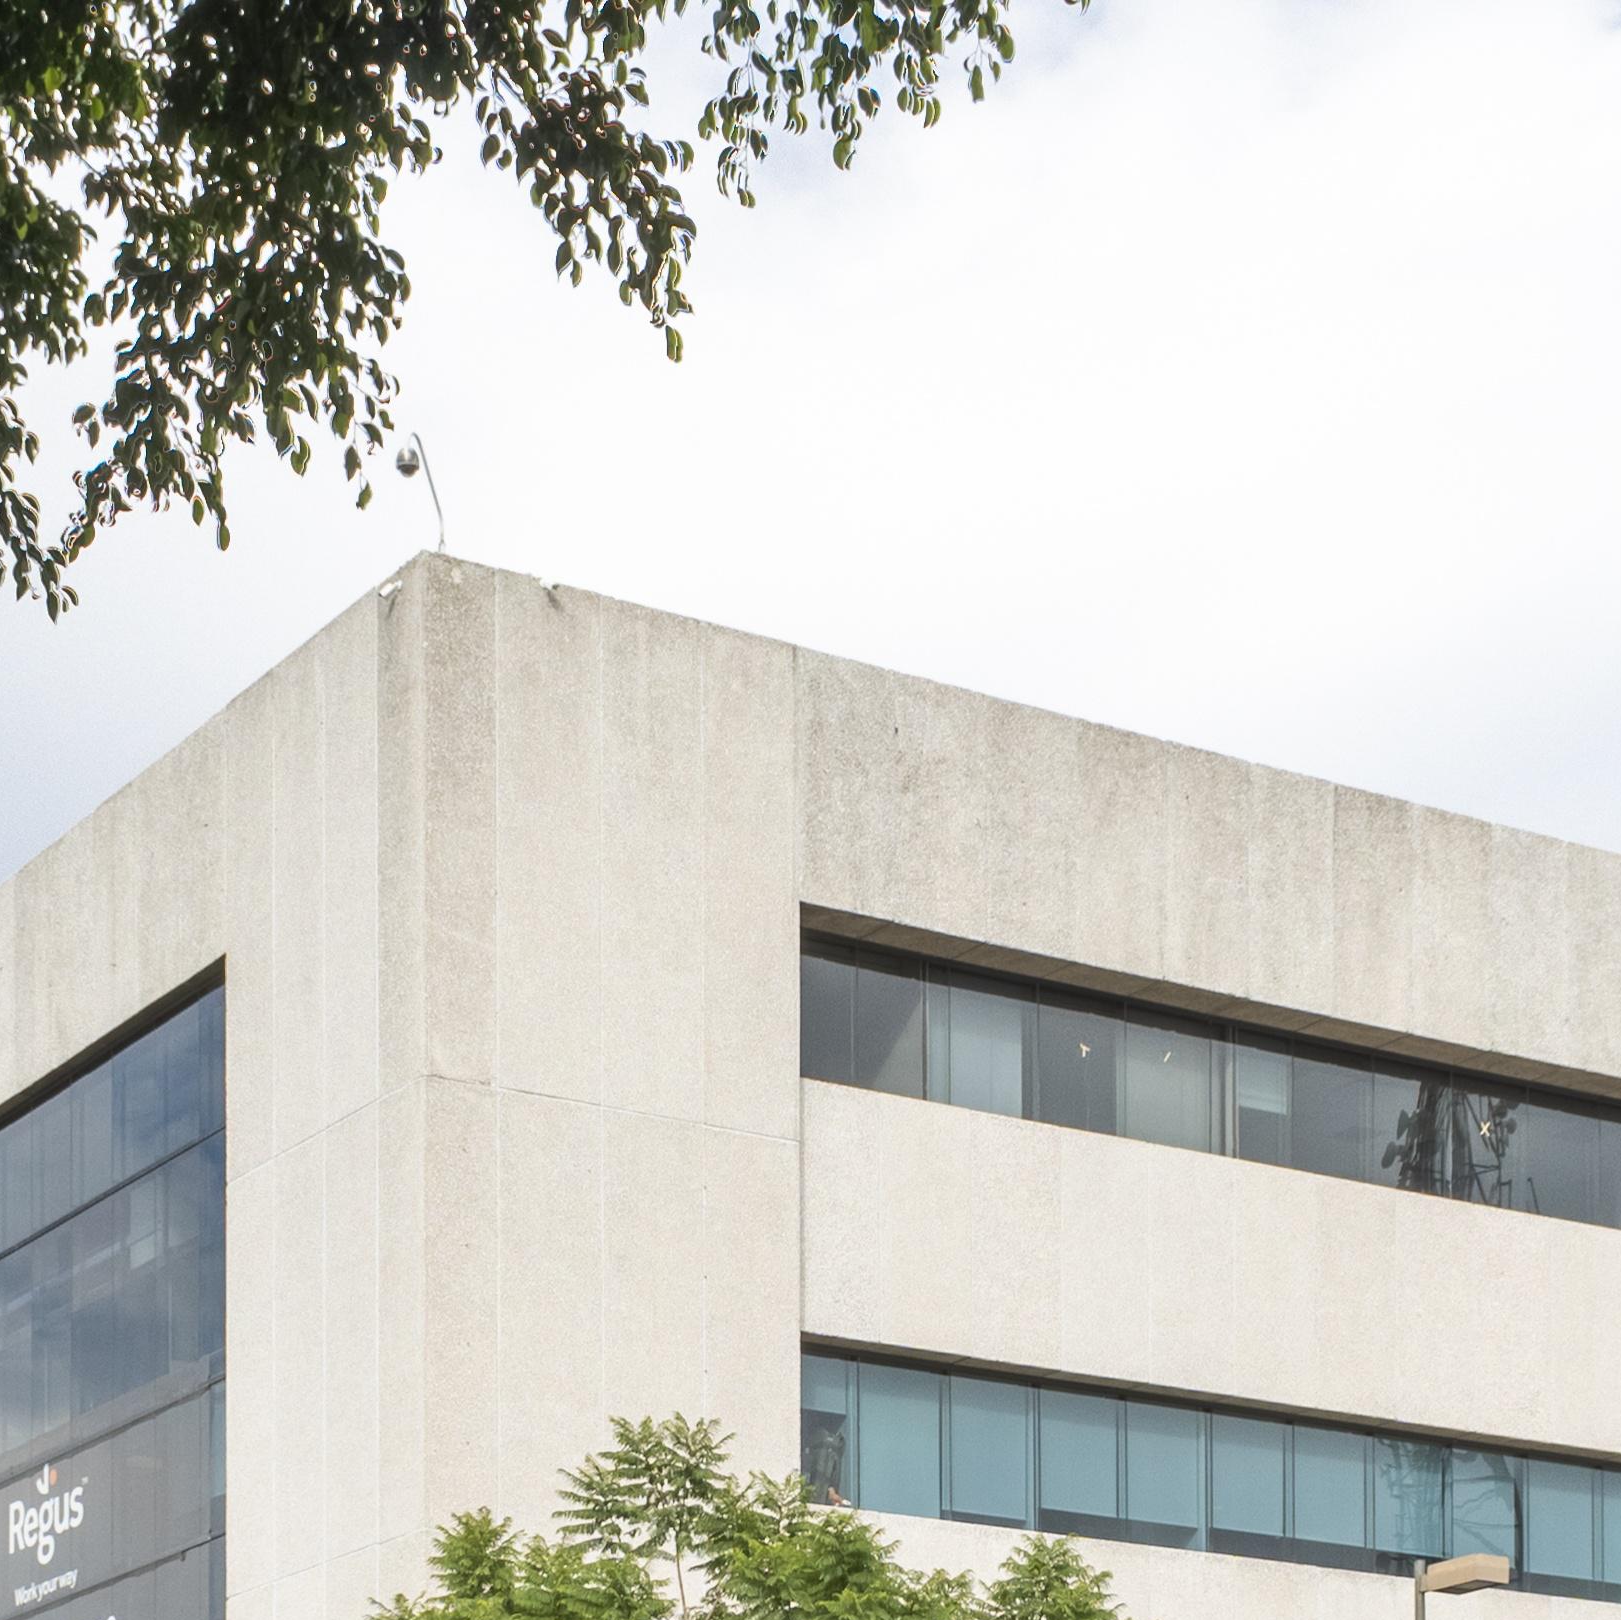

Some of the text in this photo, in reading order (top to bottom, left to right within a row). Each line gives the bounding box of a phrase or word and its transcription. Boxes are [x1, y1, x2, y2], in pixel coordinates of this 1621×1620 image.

[8, 1484, 86, 1566] Regus
[13, 1568, 79, 1607] Work your way
